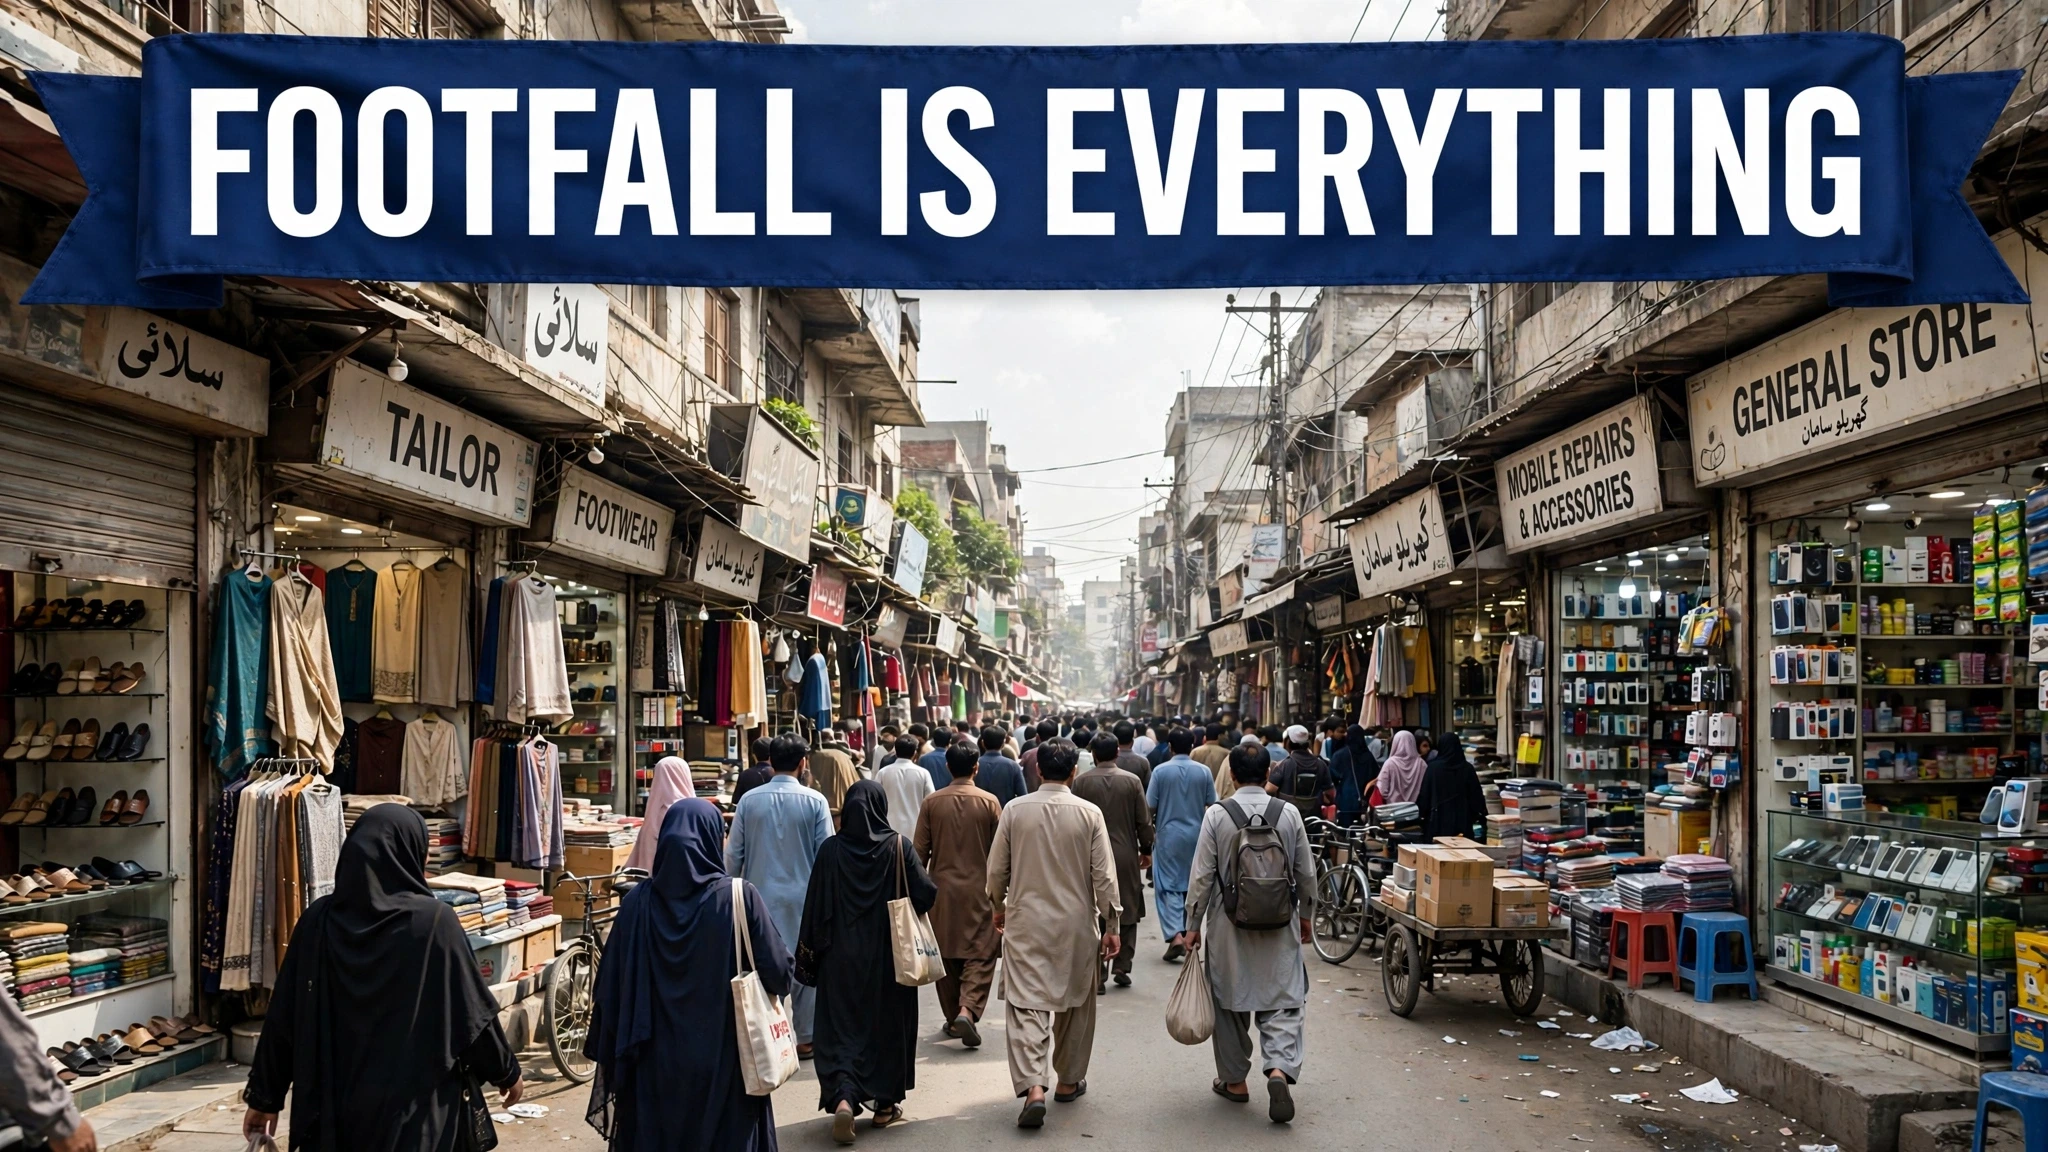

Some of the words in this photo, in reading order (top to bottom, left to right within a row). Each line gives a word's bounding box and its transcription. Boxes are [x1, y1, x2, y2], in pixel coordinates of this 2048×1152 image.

[118, 322, 224, 391] سلائی
[534, 285, 598, 365] سلائی
[1732, 343, 1861, 438] GENERAL
[1869, 303, 1997, 389] STORE
[387, 400, 502, 496] TAILOR
[1507, 448, 1560, 501] MOBILE
[1561, 416, 1636, 480] REPAIRS
[1802, 415, 1832, 445] سامان
[574, 489, 658, 551] FOOTWEAR
[1519, 508, 1529, 539] &
[1532, 470, 1634, 536] ACCESSORIES
[1361, 531, 1393, 580] سامان
